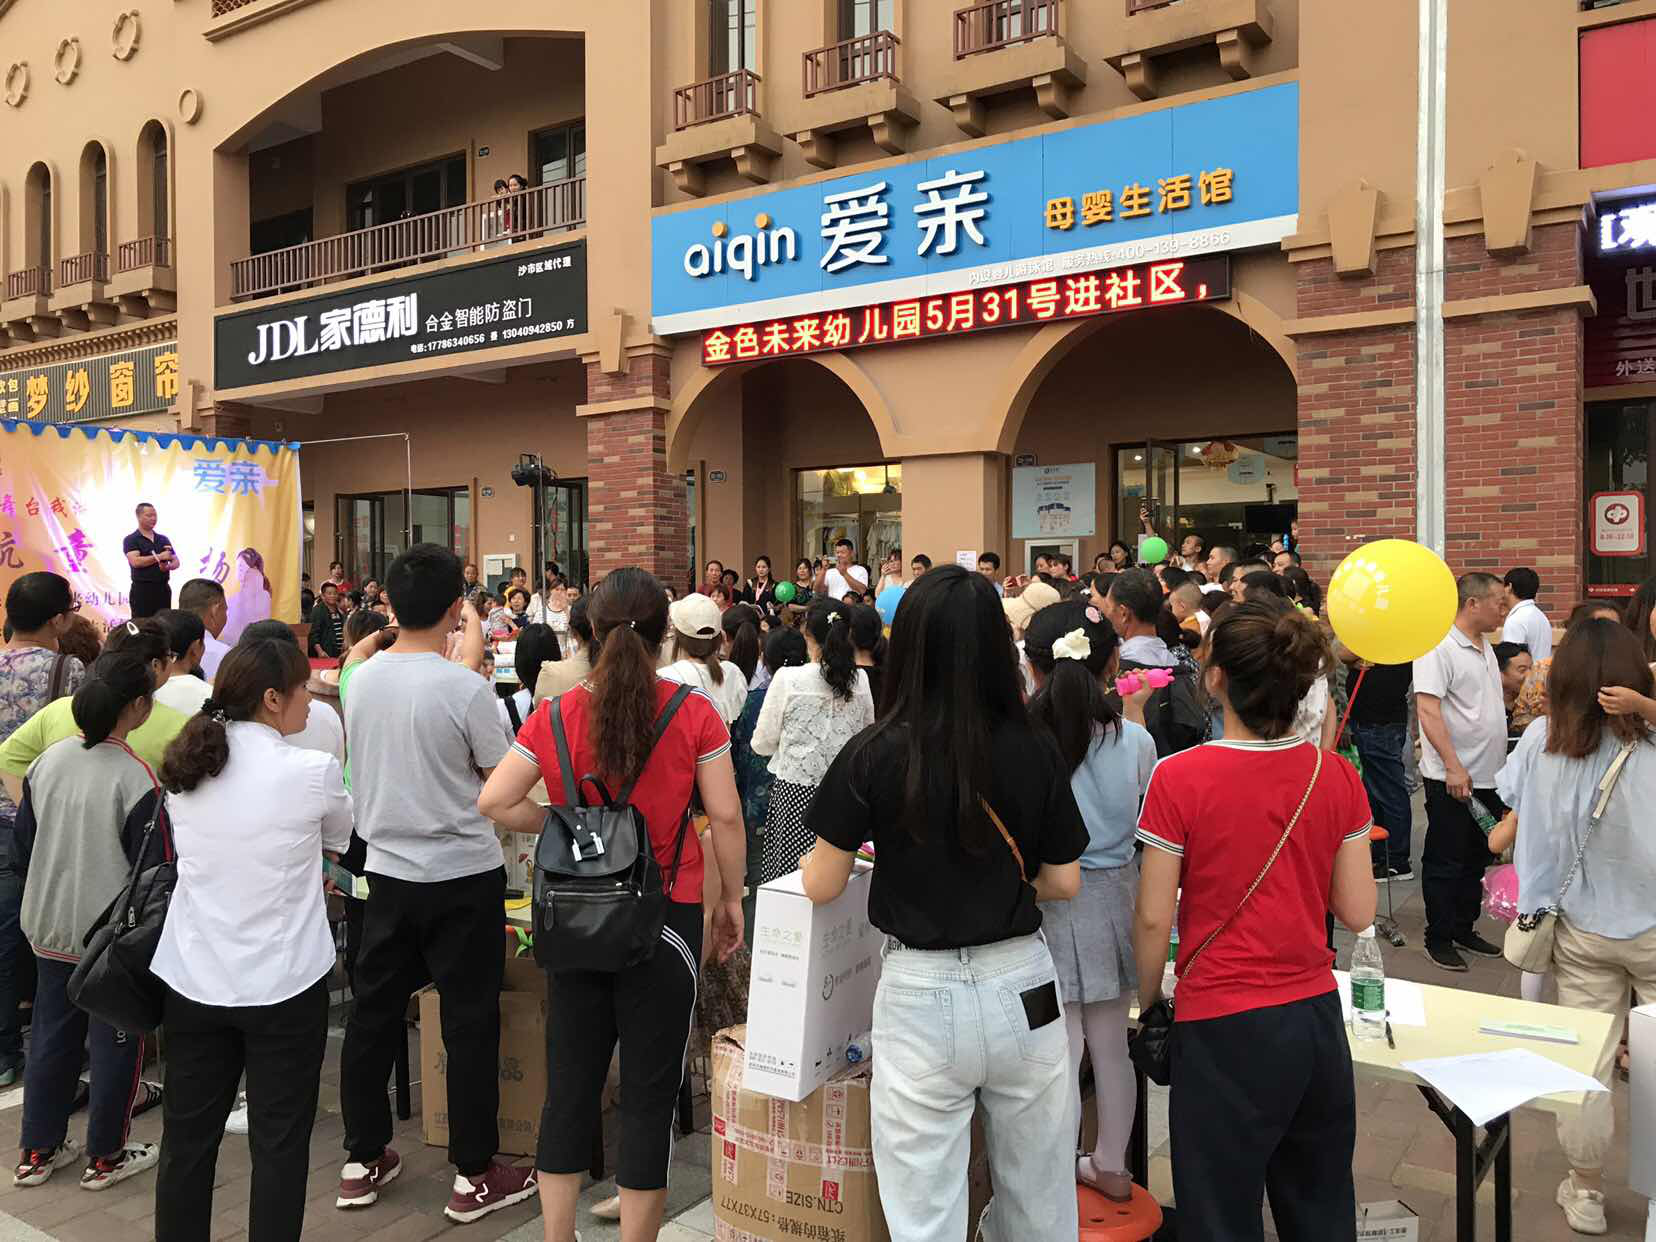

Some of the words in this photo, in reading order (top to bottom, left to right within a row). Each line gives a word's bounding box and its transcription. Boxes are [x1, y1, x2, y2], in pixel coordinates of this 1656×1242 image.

[683, 212, 797, 281] aiqin
[818, 169, 989, 272] 爱亲
[1043, 167, 1235, 232] 母婴生活馆
[424, 297, 533, 333] 合金智能防盗门
[502, 320, 563, 340] 13040942850
[193, 459, 261, 496] 爱亲
[786, 1189, 844, 1215] CTN.SIZE
